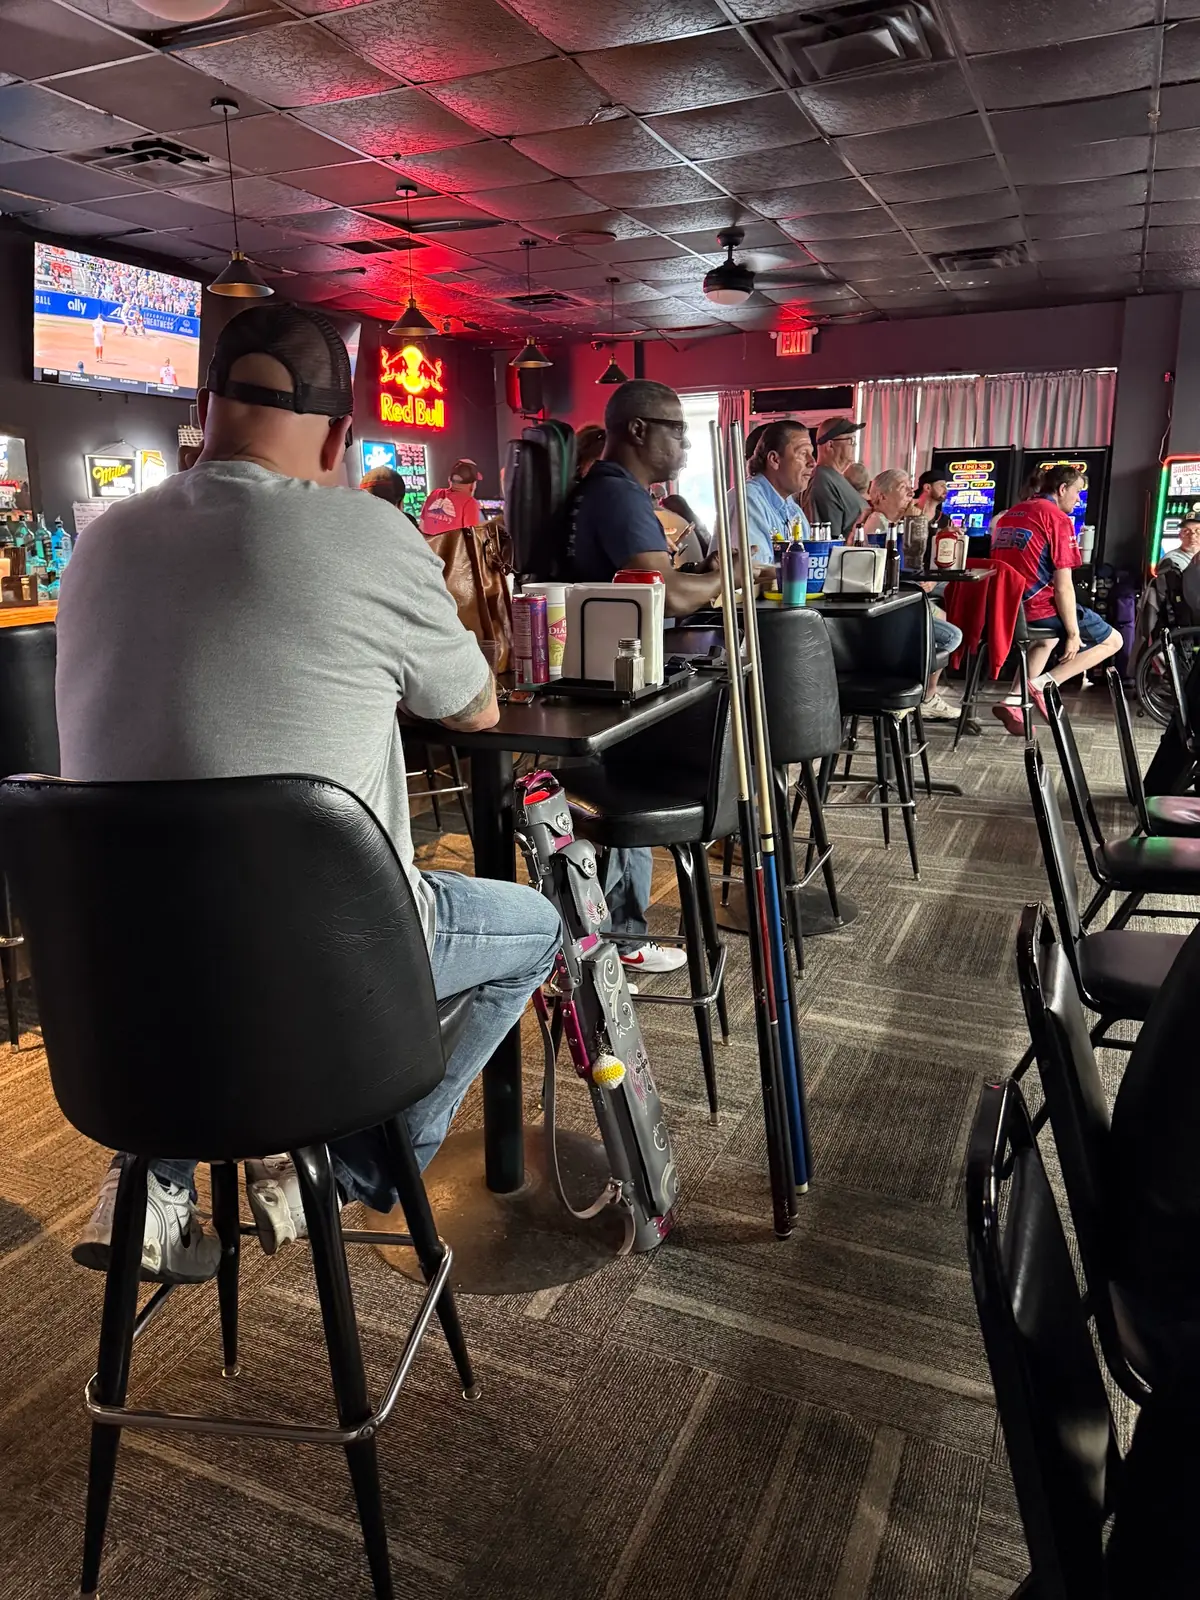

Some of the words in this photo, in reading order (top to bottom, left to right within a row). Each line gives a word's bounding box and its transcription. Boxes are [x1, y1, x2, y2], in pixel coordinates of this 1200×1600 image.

[35, 295, 51, 306] BALL
[67, 298, 87, 315] ally
[781, 331, 808, 354] EXIT
[380, 393, 414, 424] Red
[415, 398, 445, 428] Bull
[92, 464, 132, 487] Miller
[808, 556, 829, 568] BU
